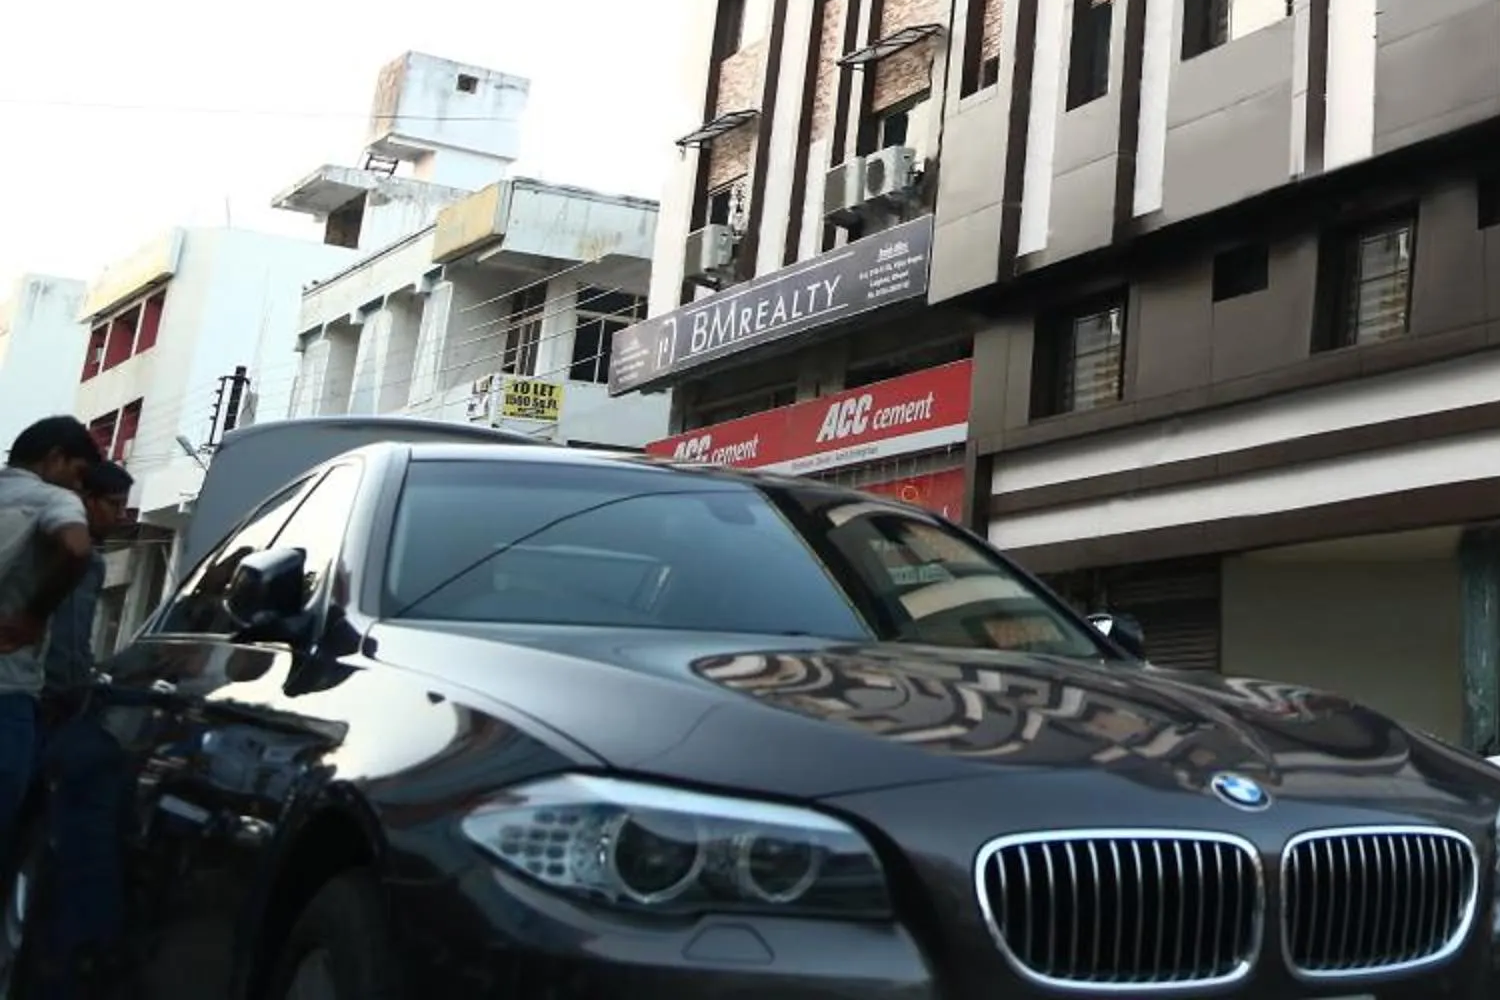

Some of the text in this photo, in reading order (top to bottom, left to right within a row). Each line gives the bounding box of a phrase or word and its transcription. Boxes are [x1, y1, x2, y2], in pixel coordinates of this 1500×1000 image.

[533, 383, 557, 397] LET
[816, 391, 935, 443] ACC cement
[711, 433, 759, 466] cement
